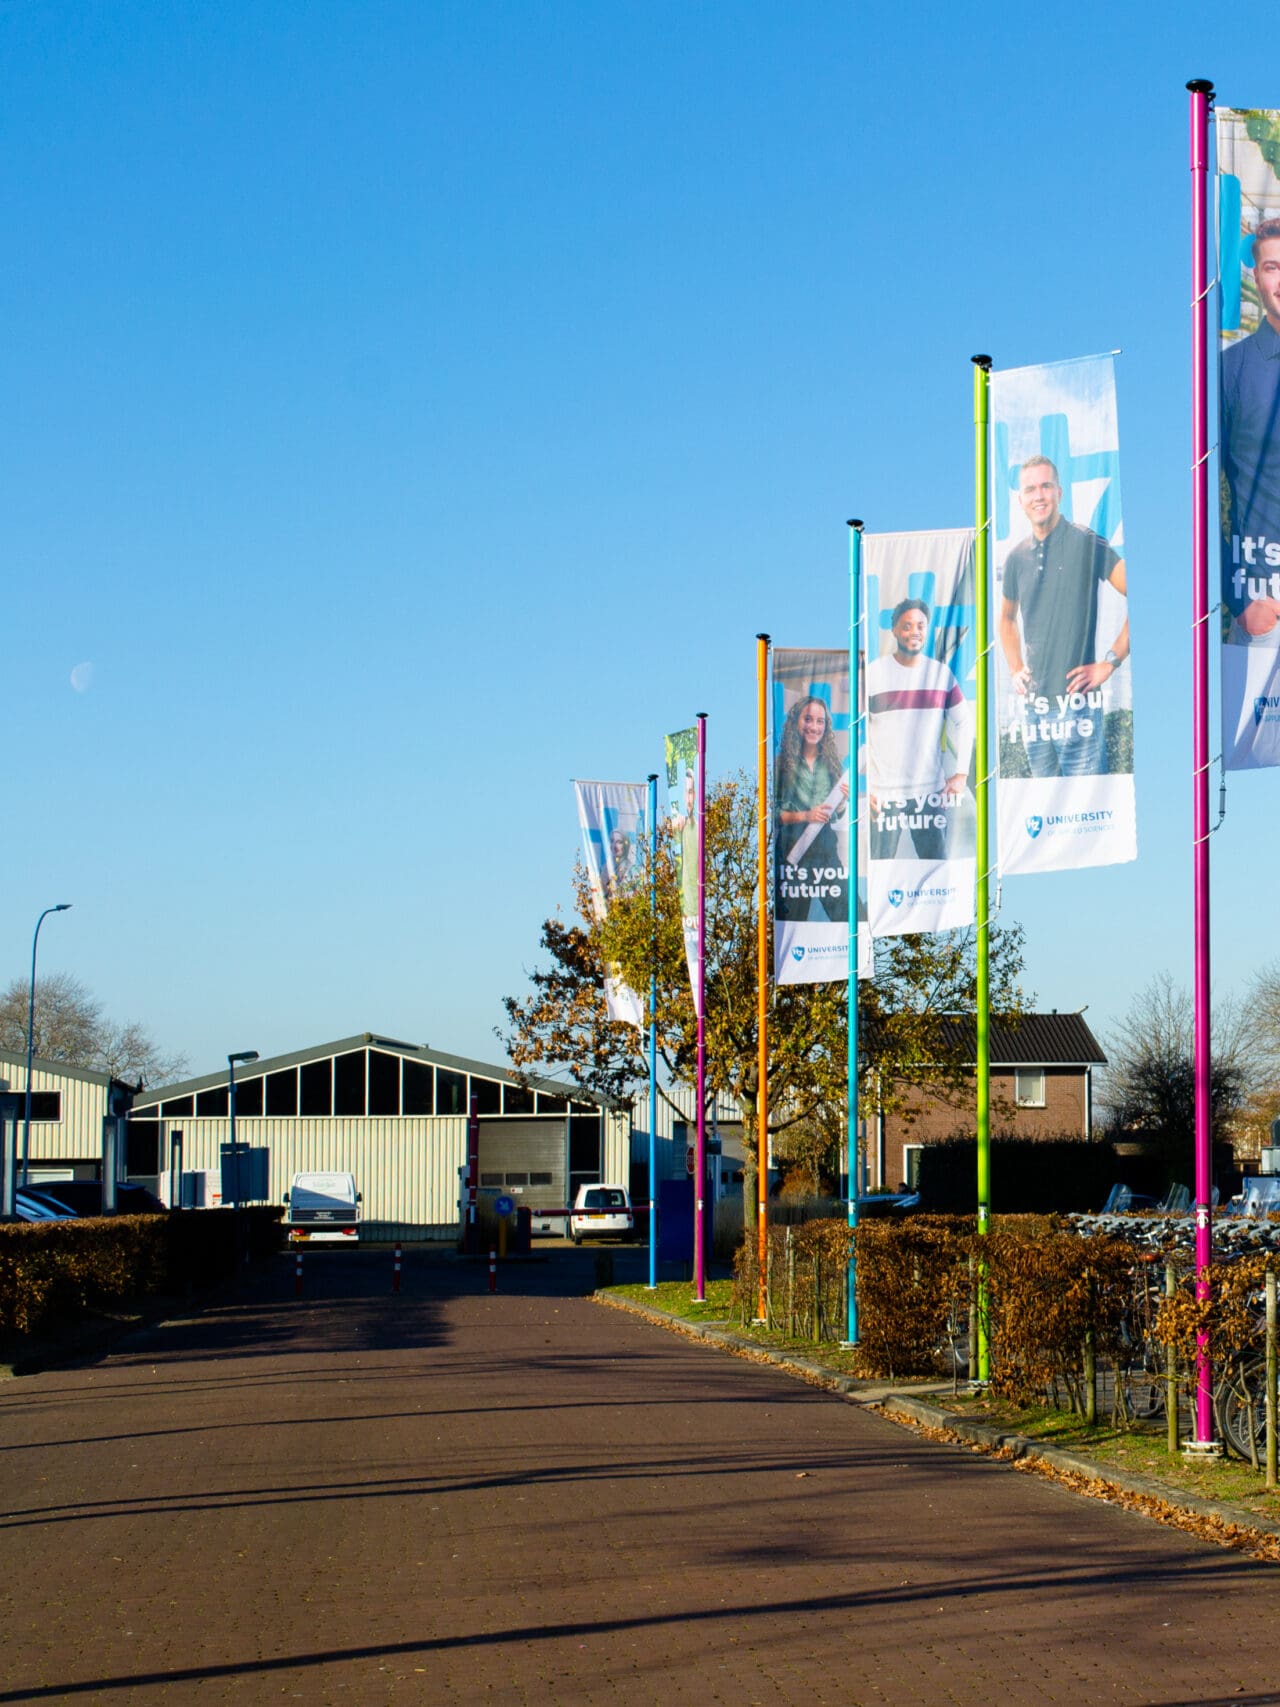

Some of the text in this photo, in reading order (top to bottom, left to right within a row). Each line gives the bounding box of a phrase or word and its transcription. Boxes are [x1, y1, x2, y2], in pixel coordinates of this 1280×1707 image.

[1055, 688, 1113, 720] your
[1008, 718, 1094, 744] future
[914, 791, 965, 814] your
[877, 812, 948, 832] future
[1046, 810, 1113, 825] UNIVERSITY
[780, 864, 848, 884] It's you
[780, 881, 842, 898] future
[808, 945, 848, 954] UNIVERSIT
